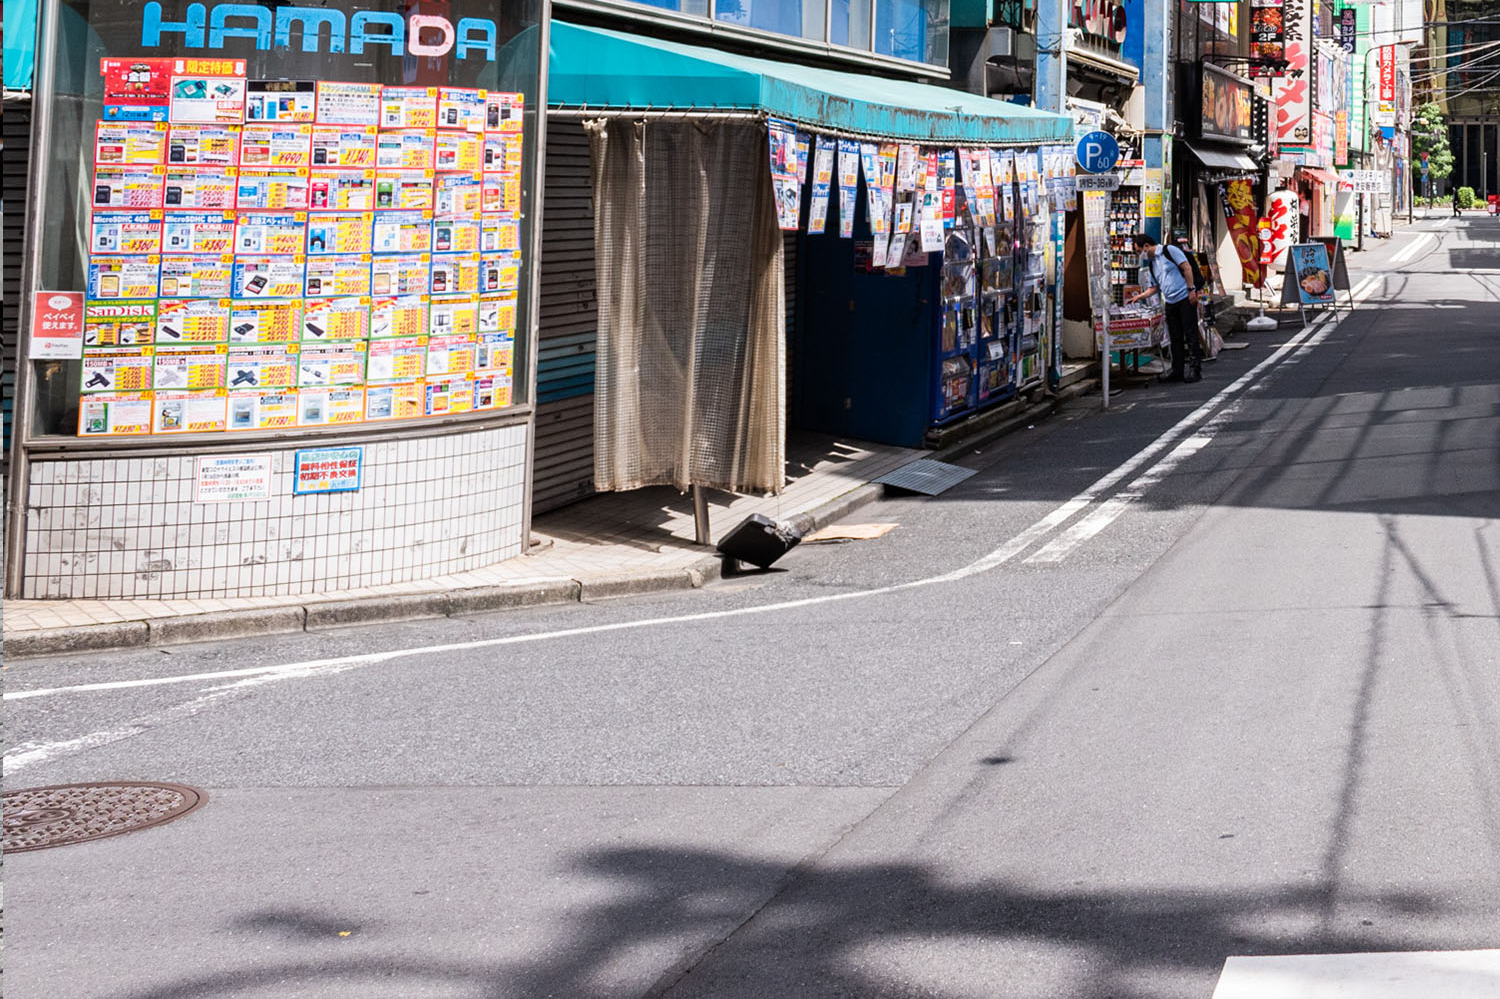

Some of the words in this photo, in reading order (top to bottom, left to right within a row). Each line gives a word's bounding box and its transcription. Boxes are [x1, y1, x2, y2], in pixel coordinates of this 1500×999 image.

[141, 1, 497, 61] HAMADA
[1258, 32, 1277, 42] 2F
[186, 60, 233, 75] 限定特価
[156, 123, 167, 131] 12
[278, 152, 303, 164] ¥990
[1086, 142, 1103, 169] P
[1097, 156, 1110, 169] 60
[150, 210, 162, 219] 27
[87, 305, 151, 317] SanDisk
